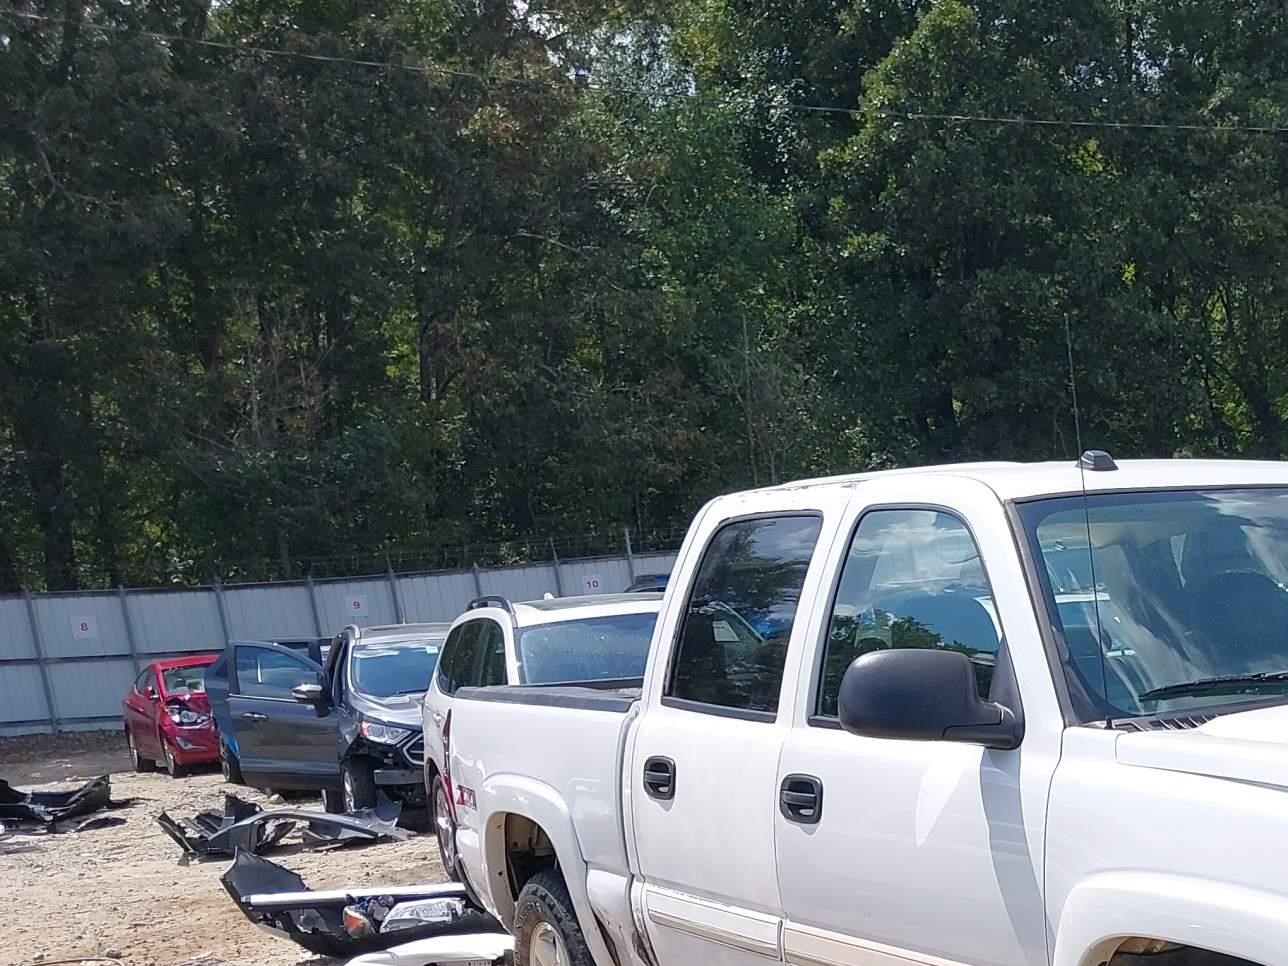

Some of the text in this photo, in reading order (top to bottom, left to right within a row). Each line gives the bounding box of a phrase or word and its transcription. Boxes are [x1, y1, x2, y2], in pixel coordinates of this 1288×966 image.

[586, 579, 599, 589] 10
[353, 600, 360, 610] 9
[80, 622, 89, 632] 8
